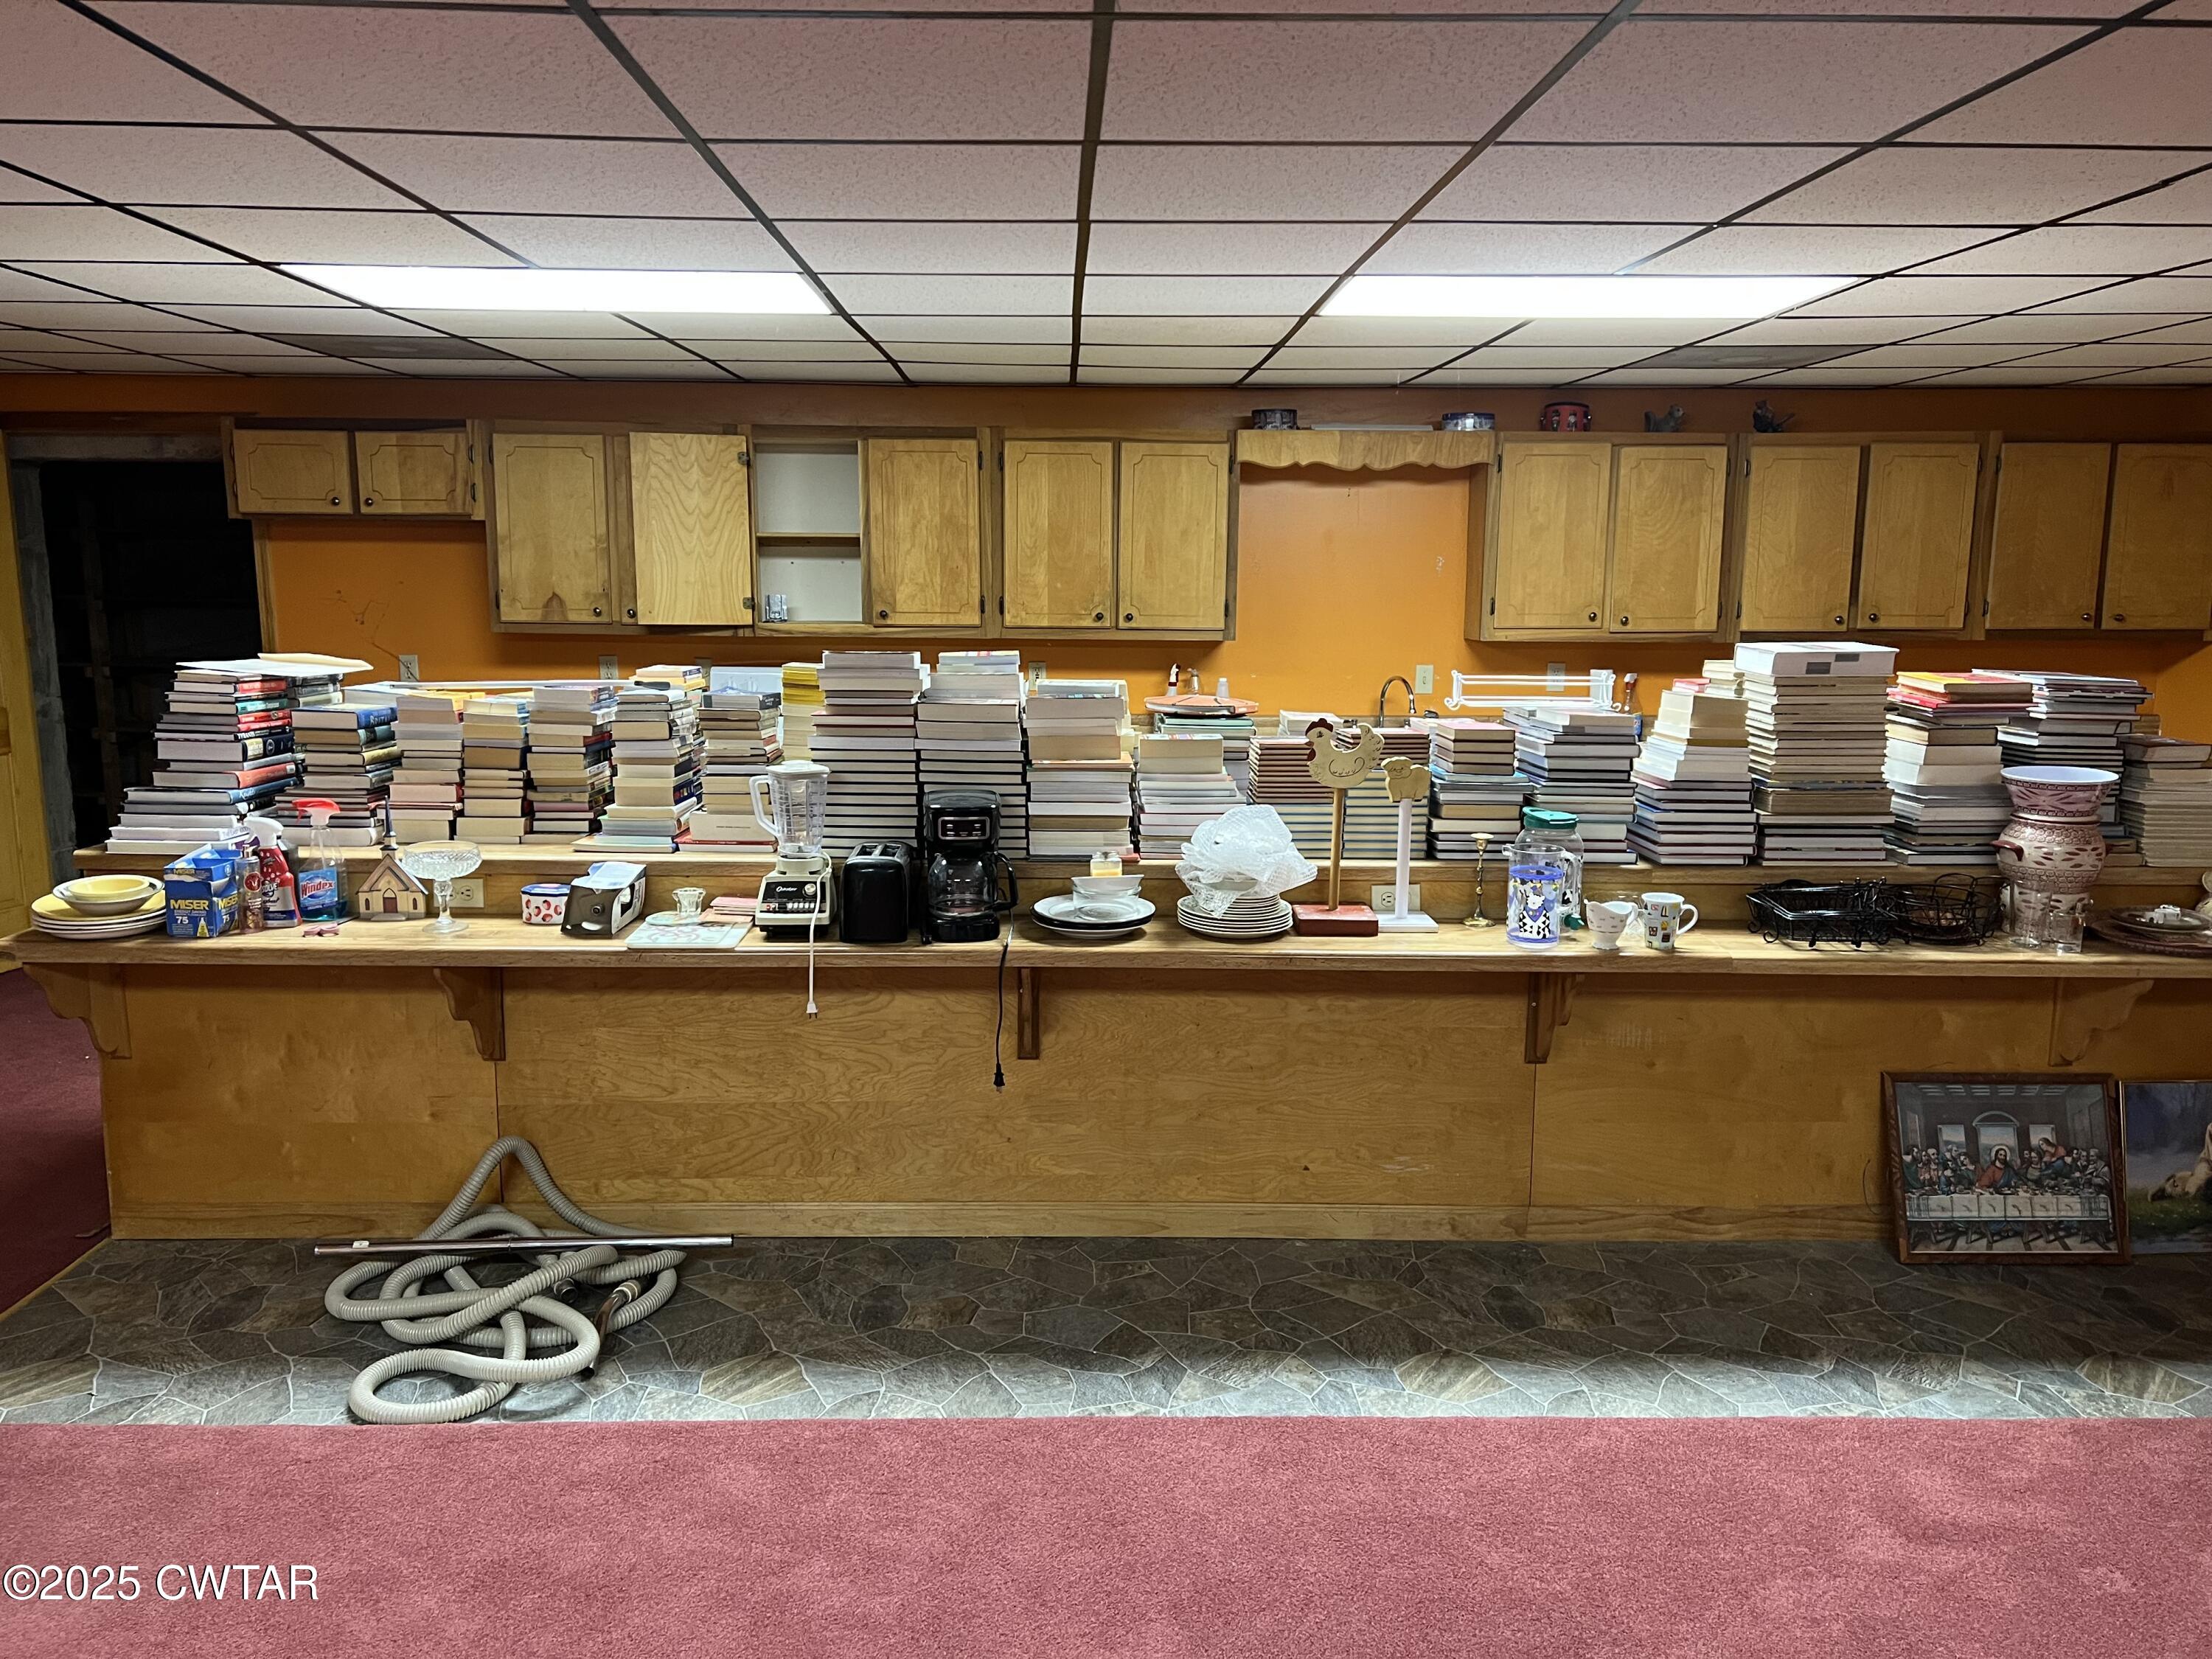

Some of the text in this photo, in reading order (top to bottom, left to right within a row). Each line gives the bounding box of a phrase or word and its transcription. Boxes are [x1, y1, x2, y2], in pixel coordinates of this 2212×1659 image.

[261, 882, 278, 893] SOLVE
[300, 880, 334, 900] Windex
[170, 900, 209, 910] MISER
